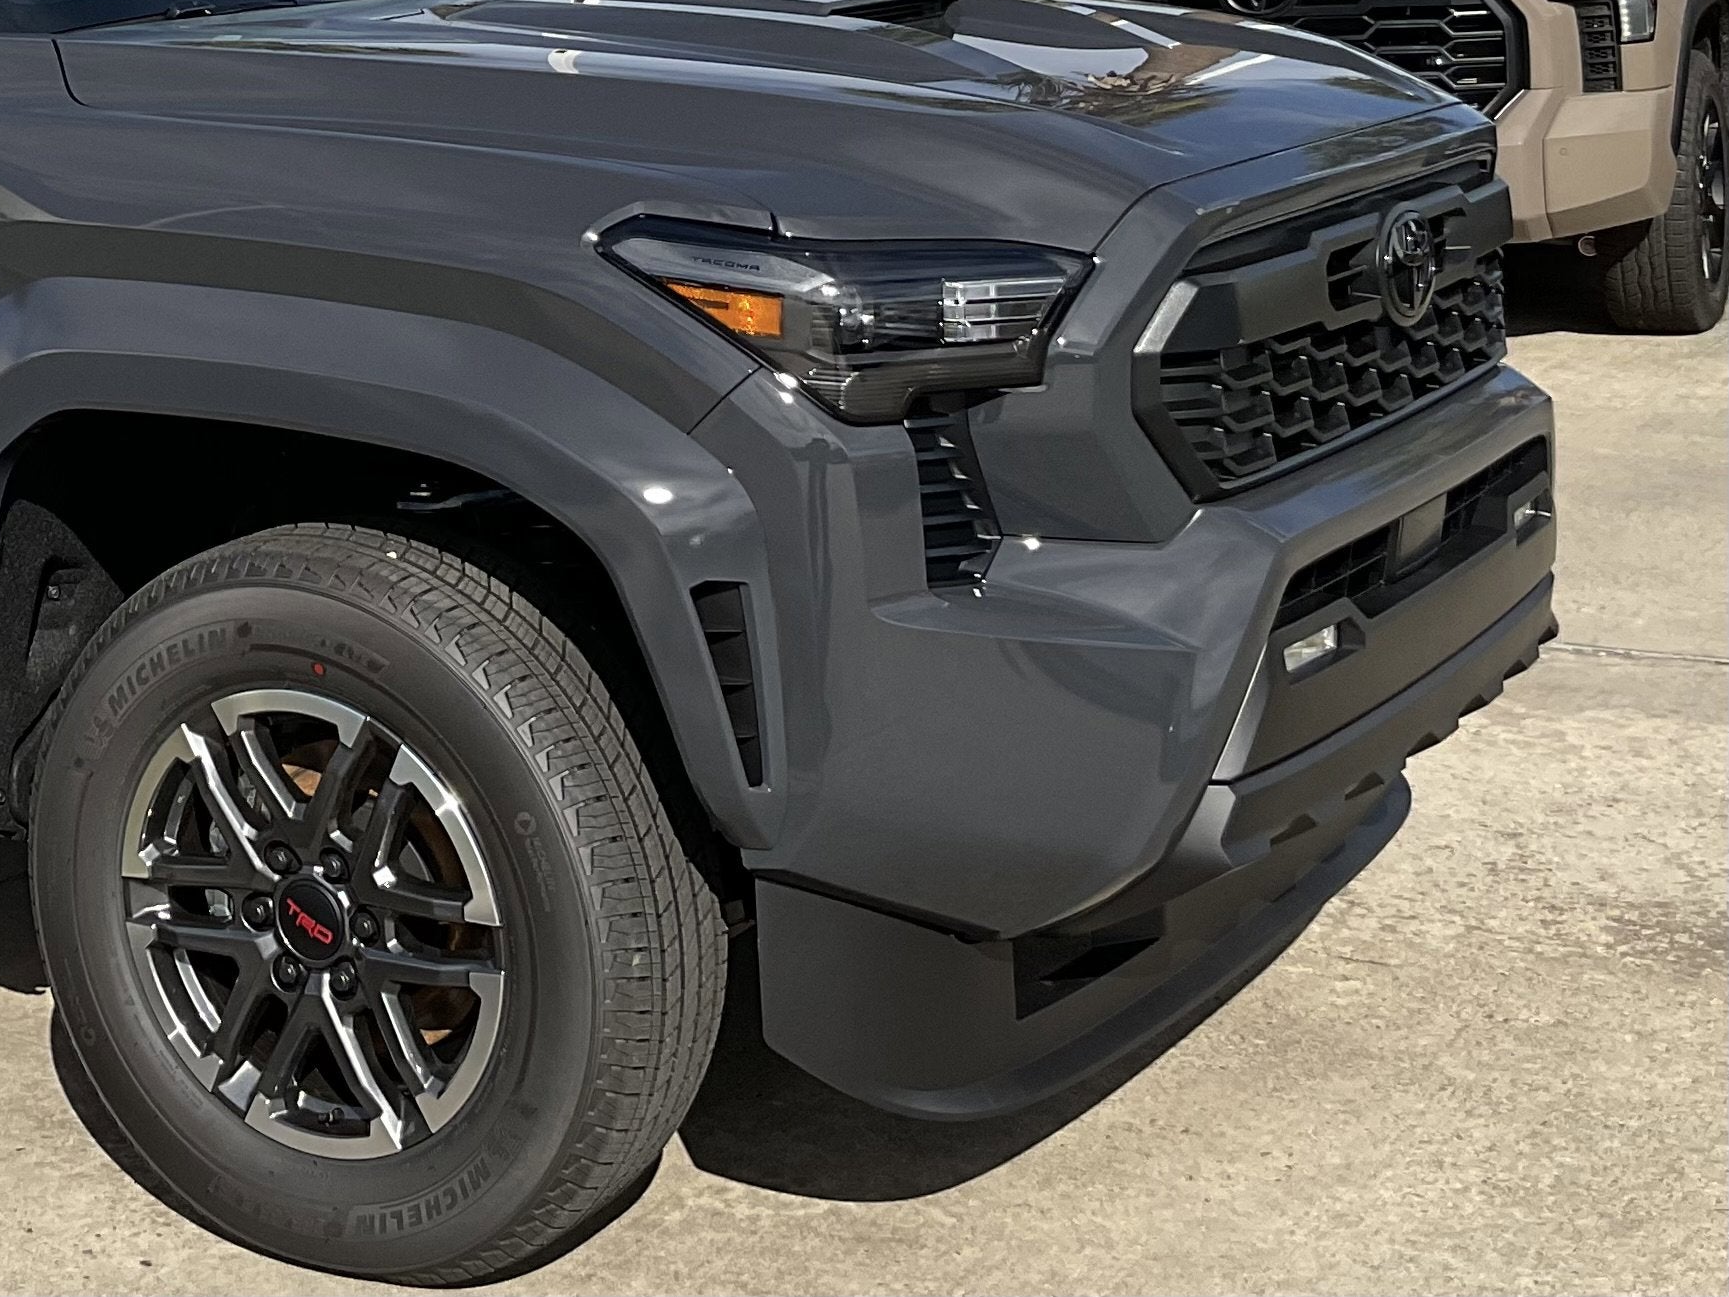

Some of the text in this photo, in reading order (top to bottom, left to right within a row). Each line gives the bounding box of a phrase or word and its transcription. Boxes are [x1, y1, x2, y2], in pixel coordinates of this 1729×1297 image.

[692, 256, 760, 271] TACOMA
[107, 627, 227, 716] MICHELIN
[286, 897, 334, 945] TRD
[355, 1157, 492, 1236] MICHELIN
